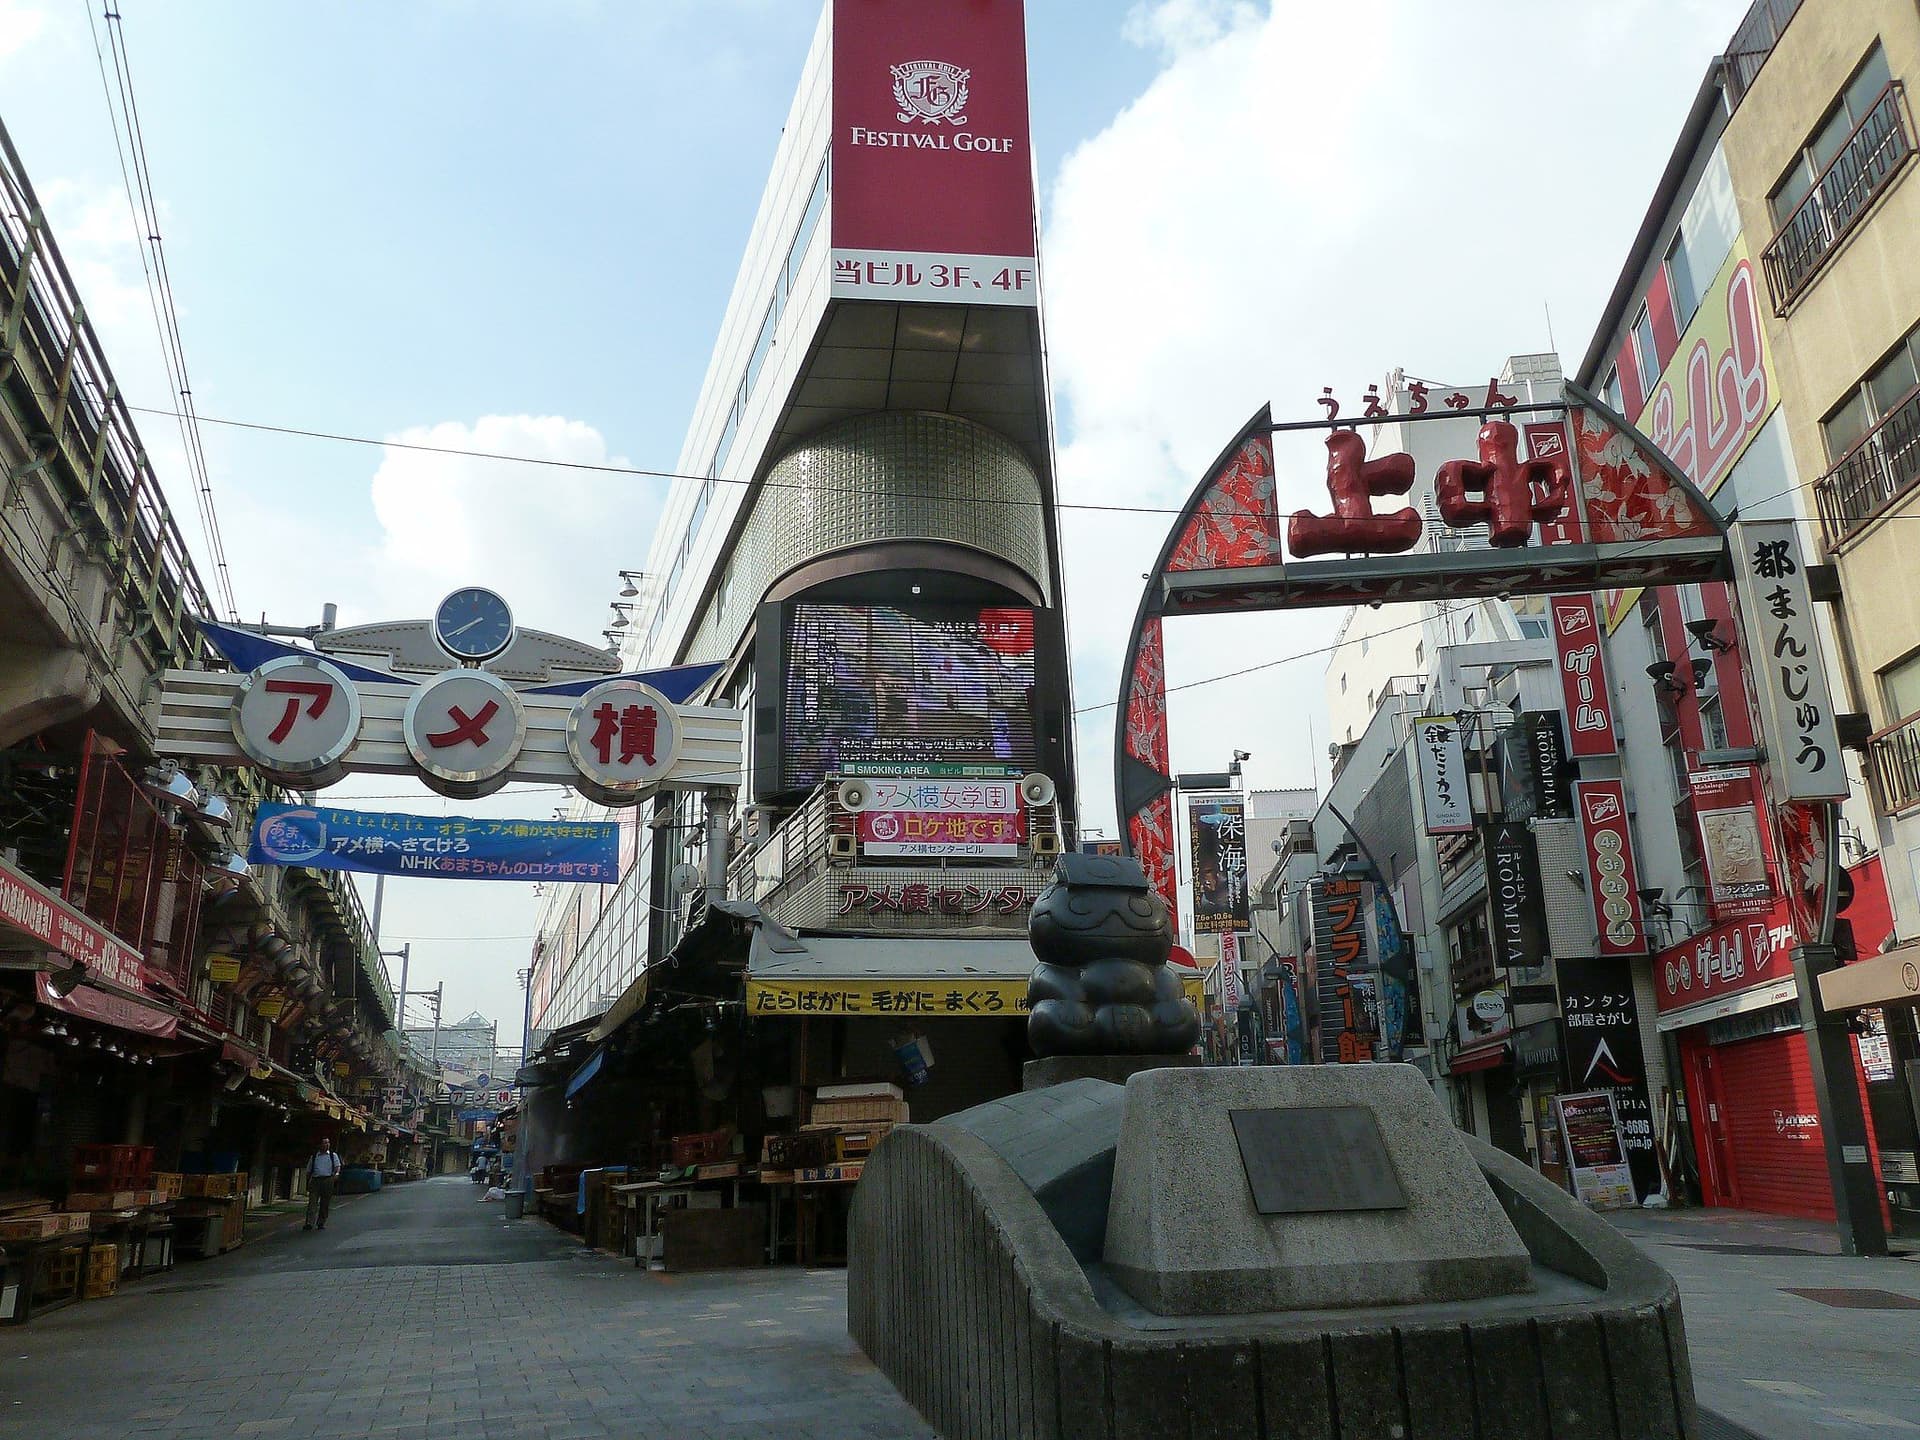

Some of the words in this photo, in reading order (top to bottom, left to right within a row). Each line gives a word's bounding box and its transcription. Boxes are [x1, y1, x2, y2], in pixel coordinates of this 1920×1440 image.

[851, 127, 950, 150] FESTIVAL
[953, 133, 1013, 153] GOLF
[835, 260, 922, 286] 当ビル
[1317, 377, 1518, 422] うえちゅん
[1288, 420, 1570, 558] 上中
[1751, 540, 1827, 774] 都まんじゅう
[1564, 643, 1608, 732] ゲーム
[265, 680, 657, 767] アメ横
[857, 766, 902, 775] SMOKING
[903, 766, 930, 775] AREA
[1536, 730, 1557, 805] ROOMPIA
[876, 784, 1007, 809] アメ横女学園
[904, 818, 1007, 838] ロケ地です
[330, 835, 471, 856] アメ横へきてけろ
[899, 844, 984, 855] アメ横センタービル
[1216, 814, 1246, 872] 深海
[1600, 836, 1617, 848] 4F
[1603, 858, 1619, 871] 3F
[1606, 880, 1623, 893] 2F
[1496, 852, 1523, 961] ROOMPIA
[1611, 903, 1626, 916] 1F
[1697, 928, 1744, 988] ゲーム!
[756, 990, 861, 1012] たらばがに
[871, 990, 935, 1012] 毛がに
[945, 990, 1004, 1012] まぐろ
[1566, 994, 1630, 1009] カンタン
[1567, 1012, 1632, 1028] 部屋さがし
